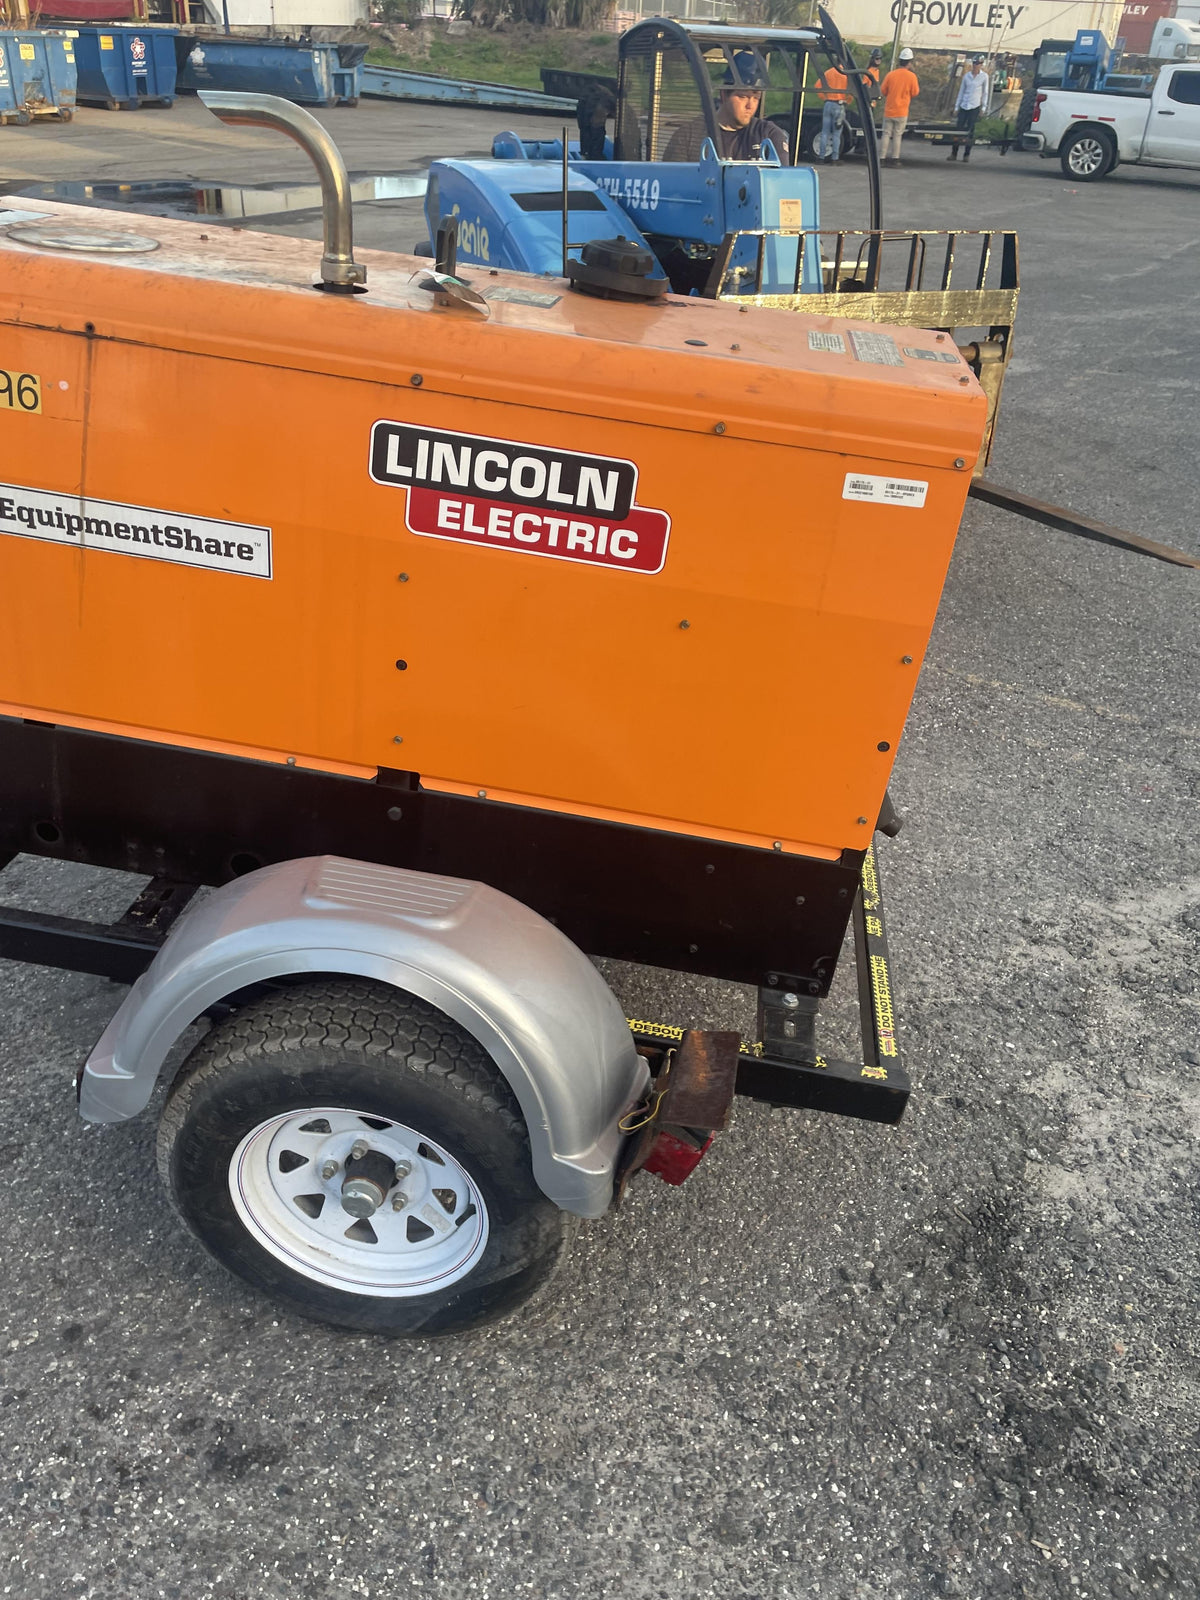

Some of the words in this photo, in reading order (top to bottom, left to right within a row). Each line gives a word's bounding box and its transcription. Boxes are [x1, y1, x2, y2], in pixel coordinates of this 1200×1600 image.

[890, 0, 1025, 30] CROWLEY
[0, 369, 39, 411] 96
[385, 433, 620, 512] LINCOLN
[0, 497, 254, 562] EquipmentShare
[437, 498, 639, 560] ELECTRIC
[876, 968, 887, 995] STAND
[880, 997, 889, 1014] NOT
[882, 1015, 891, 1028] DO
